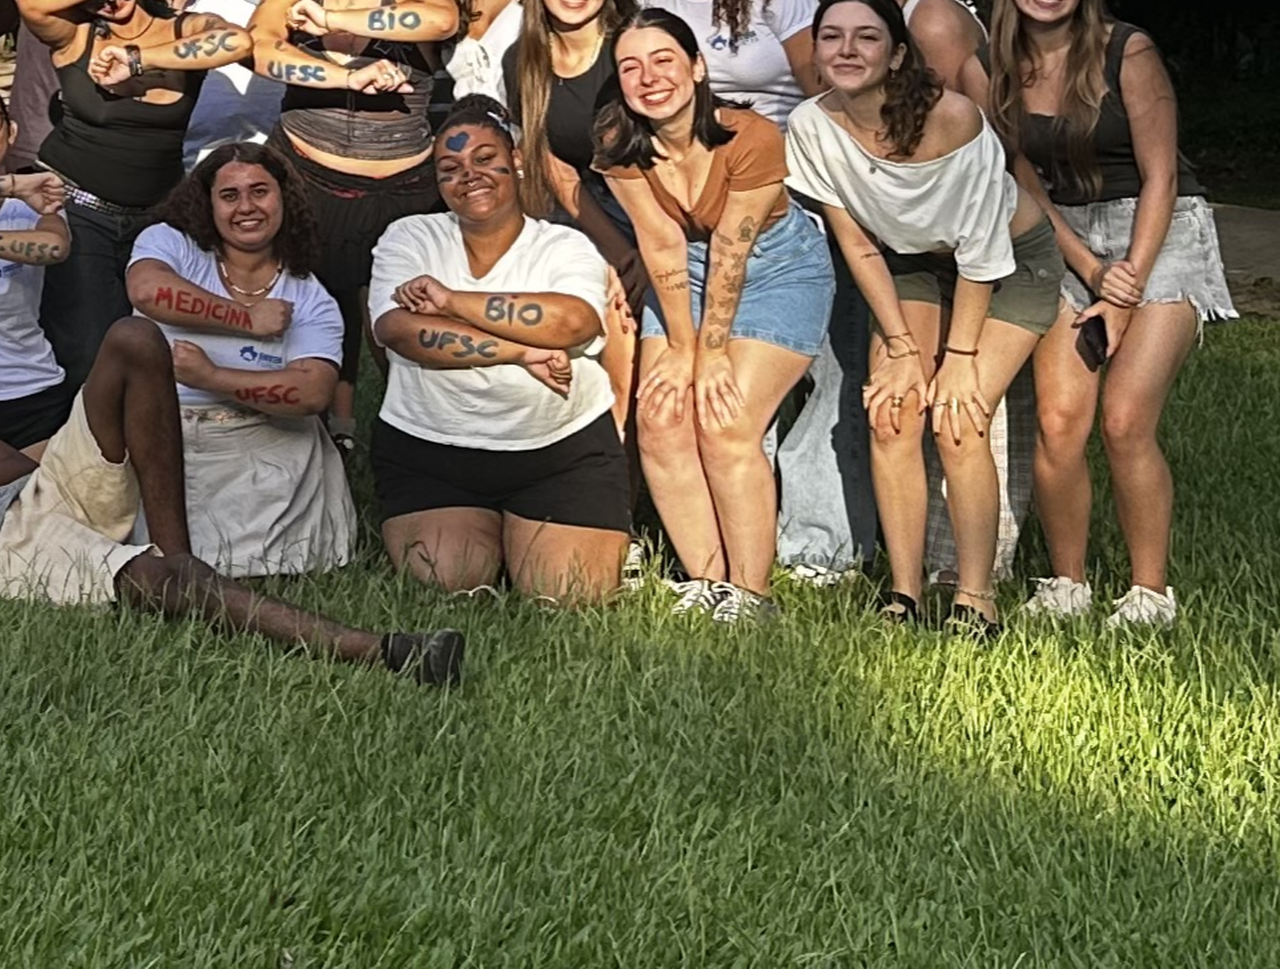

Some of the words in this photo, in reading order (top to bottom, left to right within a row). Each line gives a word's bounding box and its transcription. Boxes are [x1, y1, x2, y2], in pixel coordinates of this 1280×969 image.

[367, 6, 421, 32] BIO
[173, 32, 238, 59] UFSC
[267, 60, 328, 82] UFSC
[155, 286, 253, 330] MEDICINA
[484, 294, 545, 327] BIO
[418, 328, 499, 358] UFSC
[234, 384, 300, 405] UFSC
